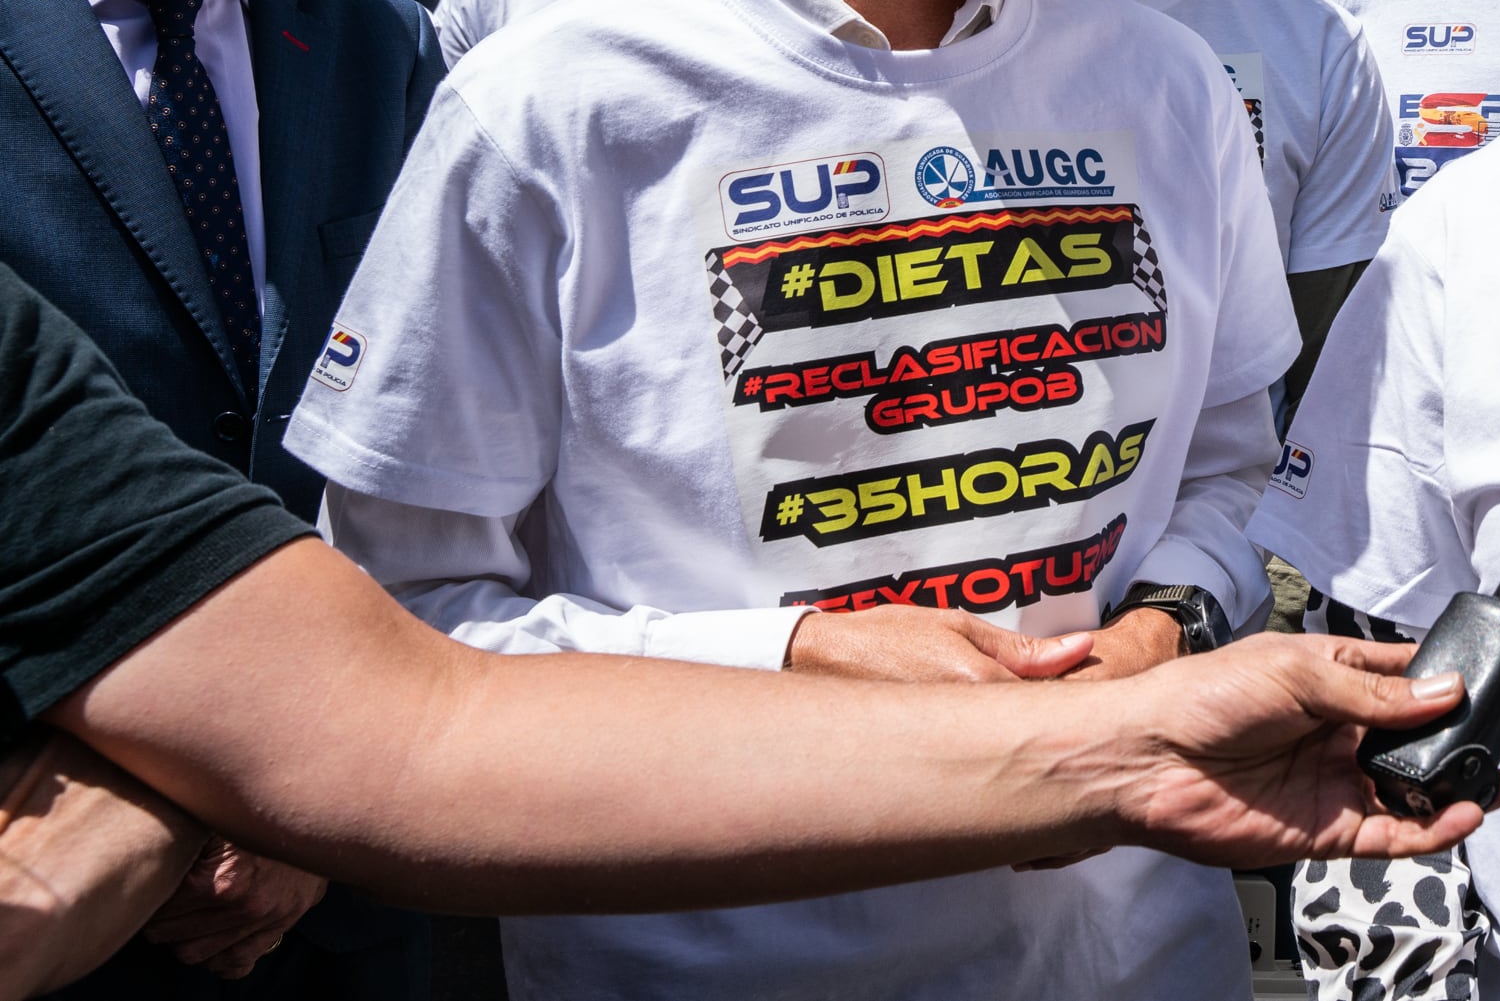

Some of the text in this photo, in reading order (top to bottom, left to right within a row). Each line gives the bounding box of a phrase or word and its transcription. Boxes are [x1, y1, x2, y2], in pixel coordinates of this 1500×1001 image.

[1405, 26, 1474, 48] SUP
[728, 158, 881, 226] SUP
[983, 148, 1106, 187] AUGC
[732, 207, 884, 236] SINDICATO UNIFICADO DE POLICIA
[780, 232, 1114, 313] #DIETAS
[871, 370, 1078, 428] GRUPOB
[775, 433, 1145, 535] #35HORAS
